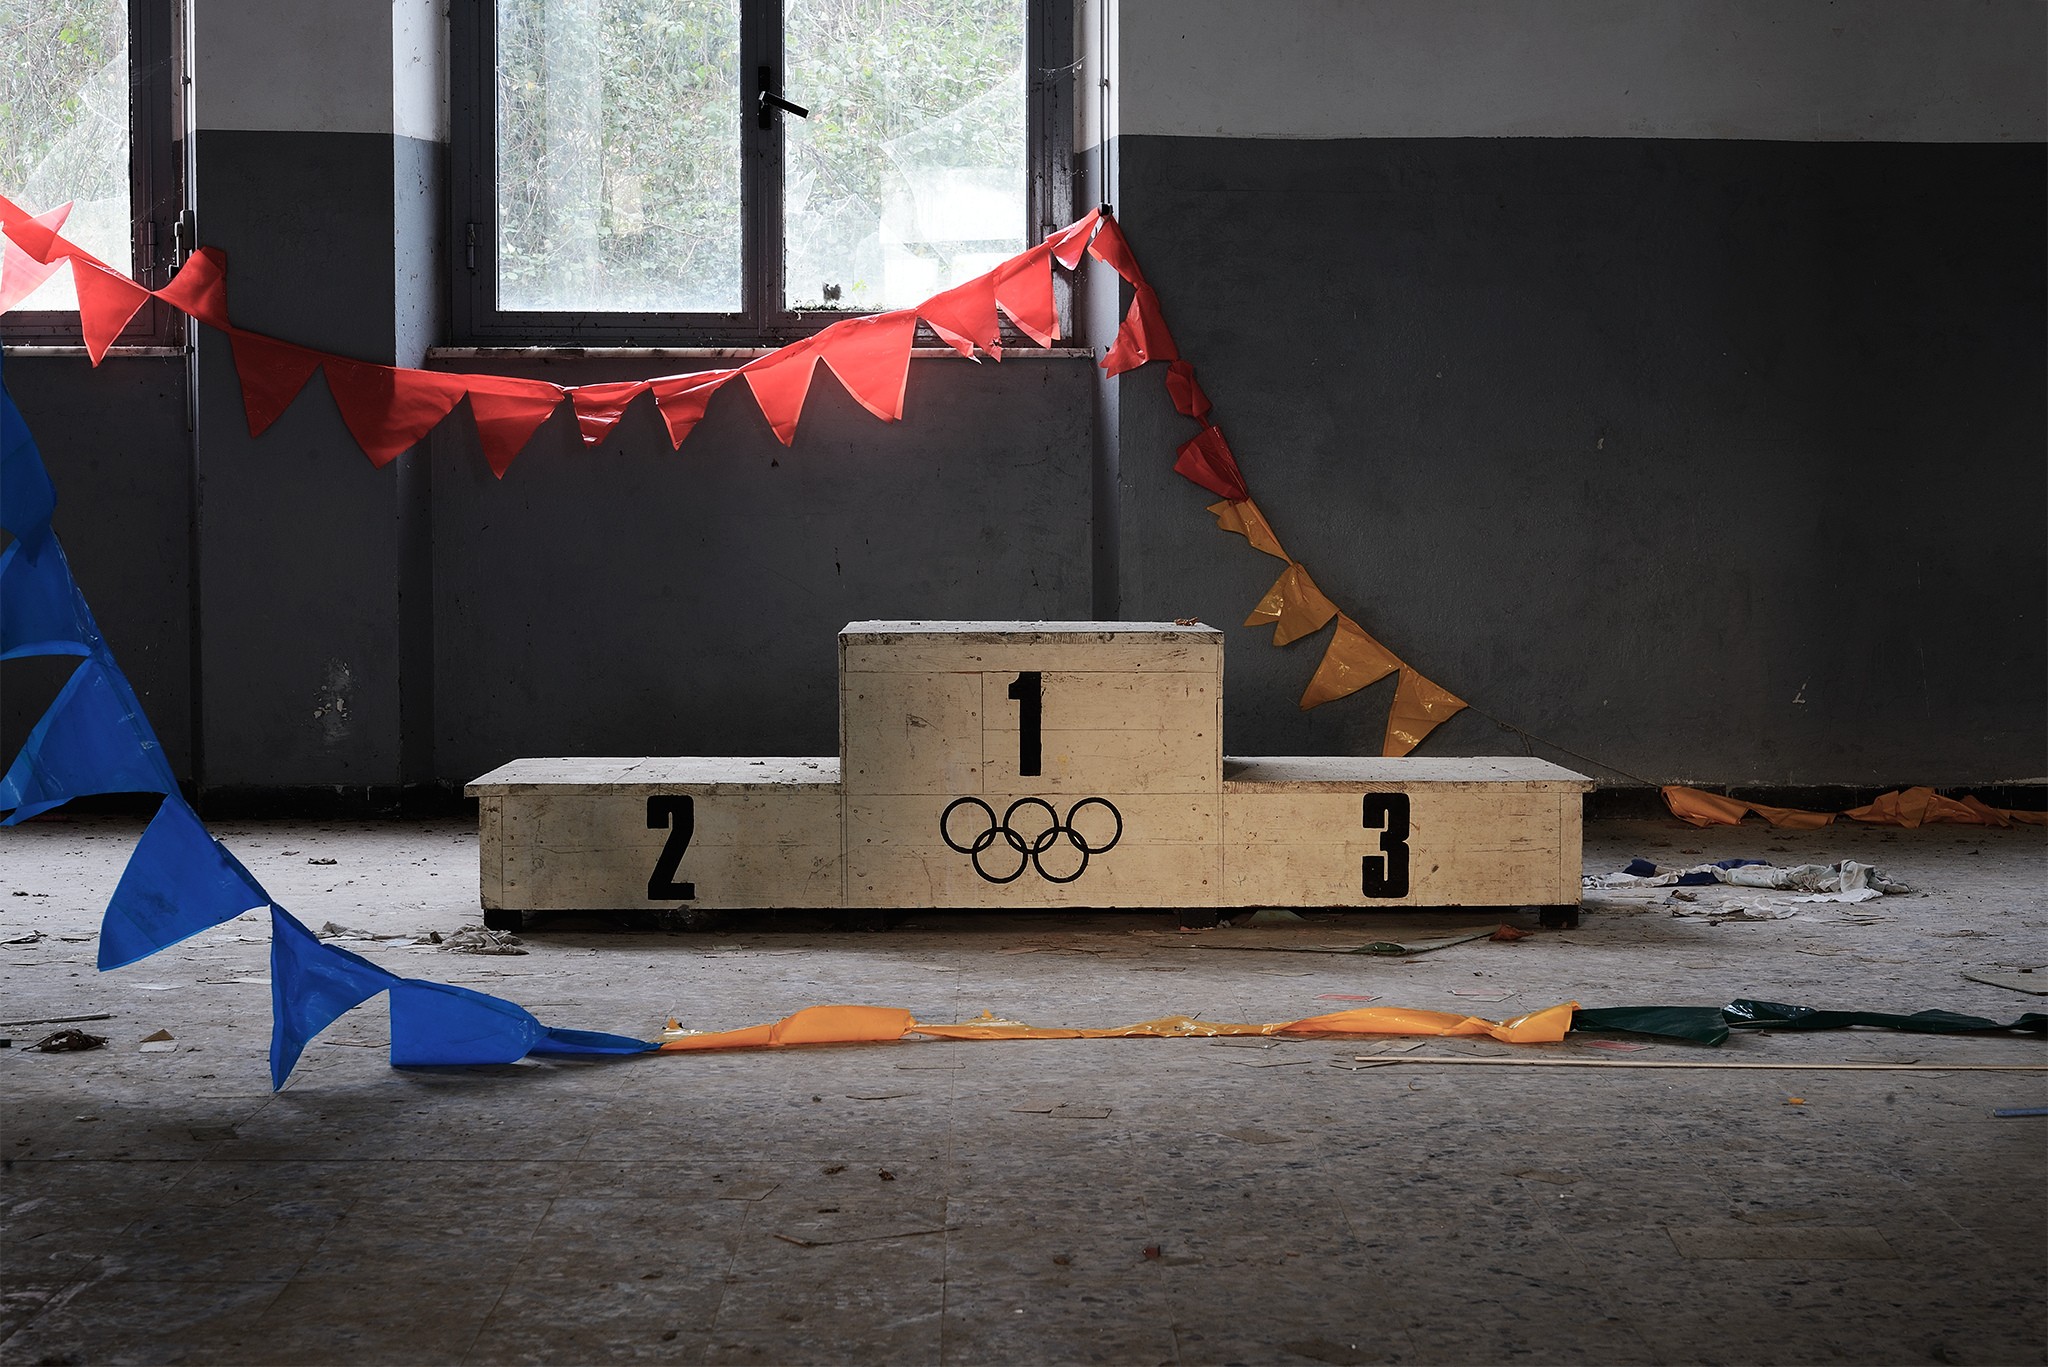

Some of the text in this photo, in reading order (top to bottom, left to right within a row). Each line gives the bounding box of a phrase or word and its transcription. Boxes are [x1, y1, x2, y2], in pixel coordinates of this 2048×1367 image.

[1008, 671, 1043, 777] 1
[646, 794, 696, 901] 2
[1361, 792, 1411, 899] 3
